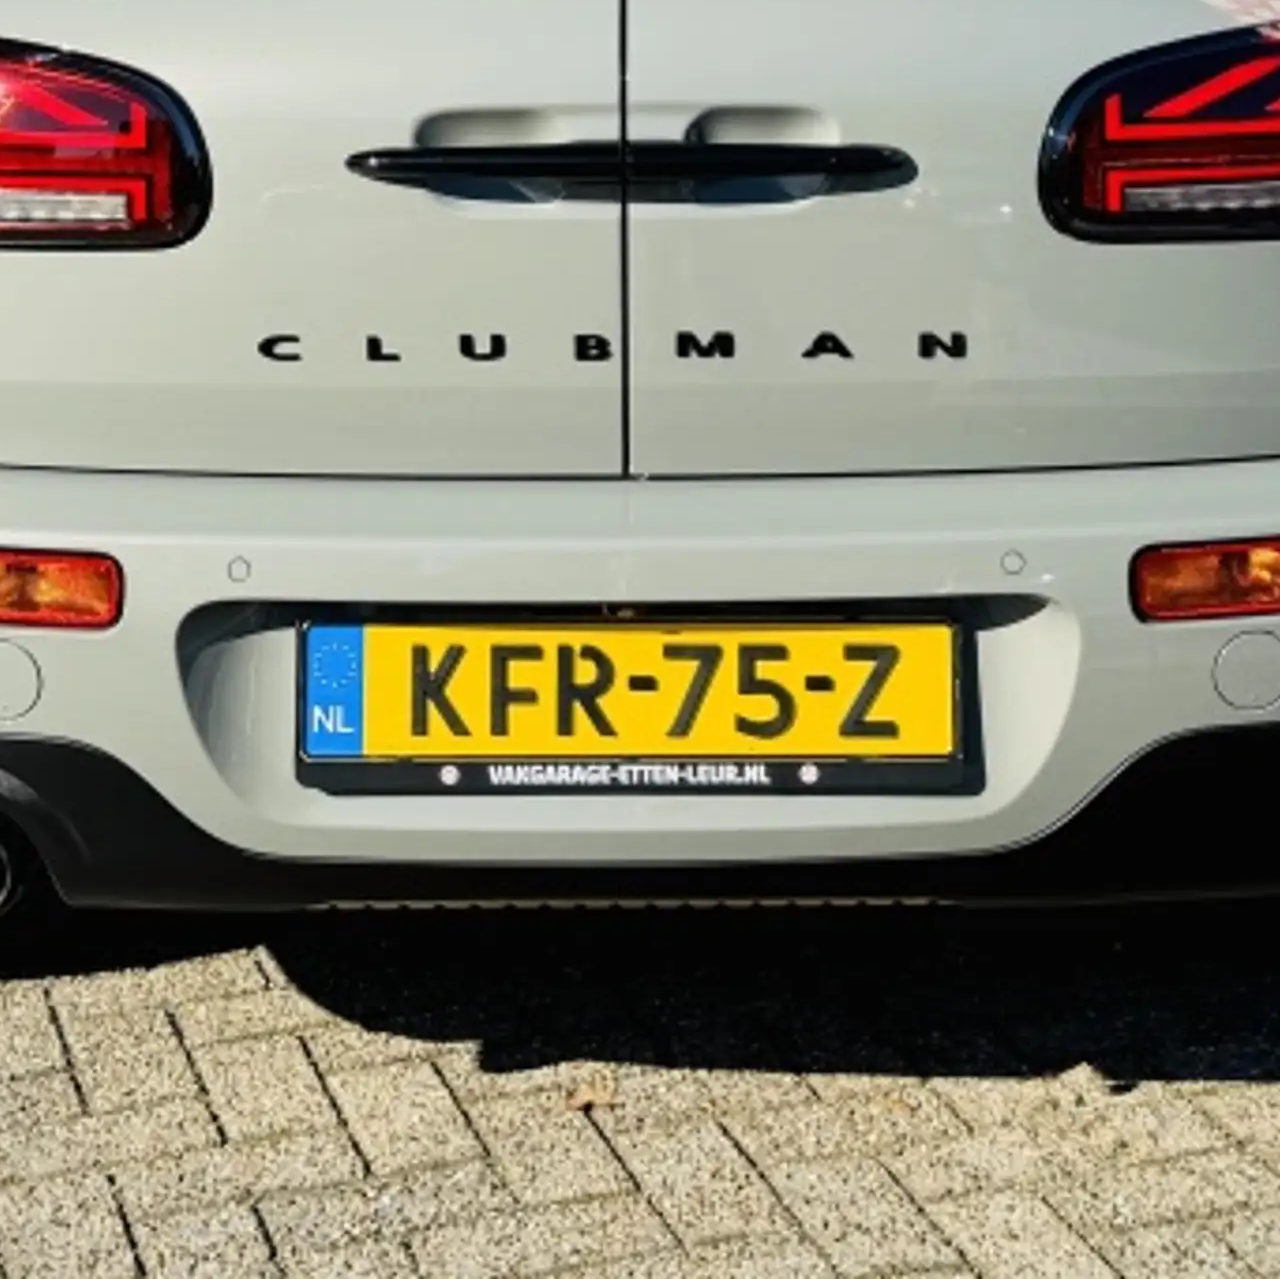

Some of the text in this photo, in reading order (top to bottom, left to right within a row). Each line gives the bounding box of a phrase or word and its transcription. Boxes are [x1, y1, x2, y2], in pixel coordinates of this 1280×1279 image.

[257, 330, 969, 362] CLUBMAN
[410, 643, 902, 740] KFR-75-Z
[312, 704, 356, 734] NL
[487, 763, 772, 786] VAKGARAGE-ETTEN-LEUR.NL
